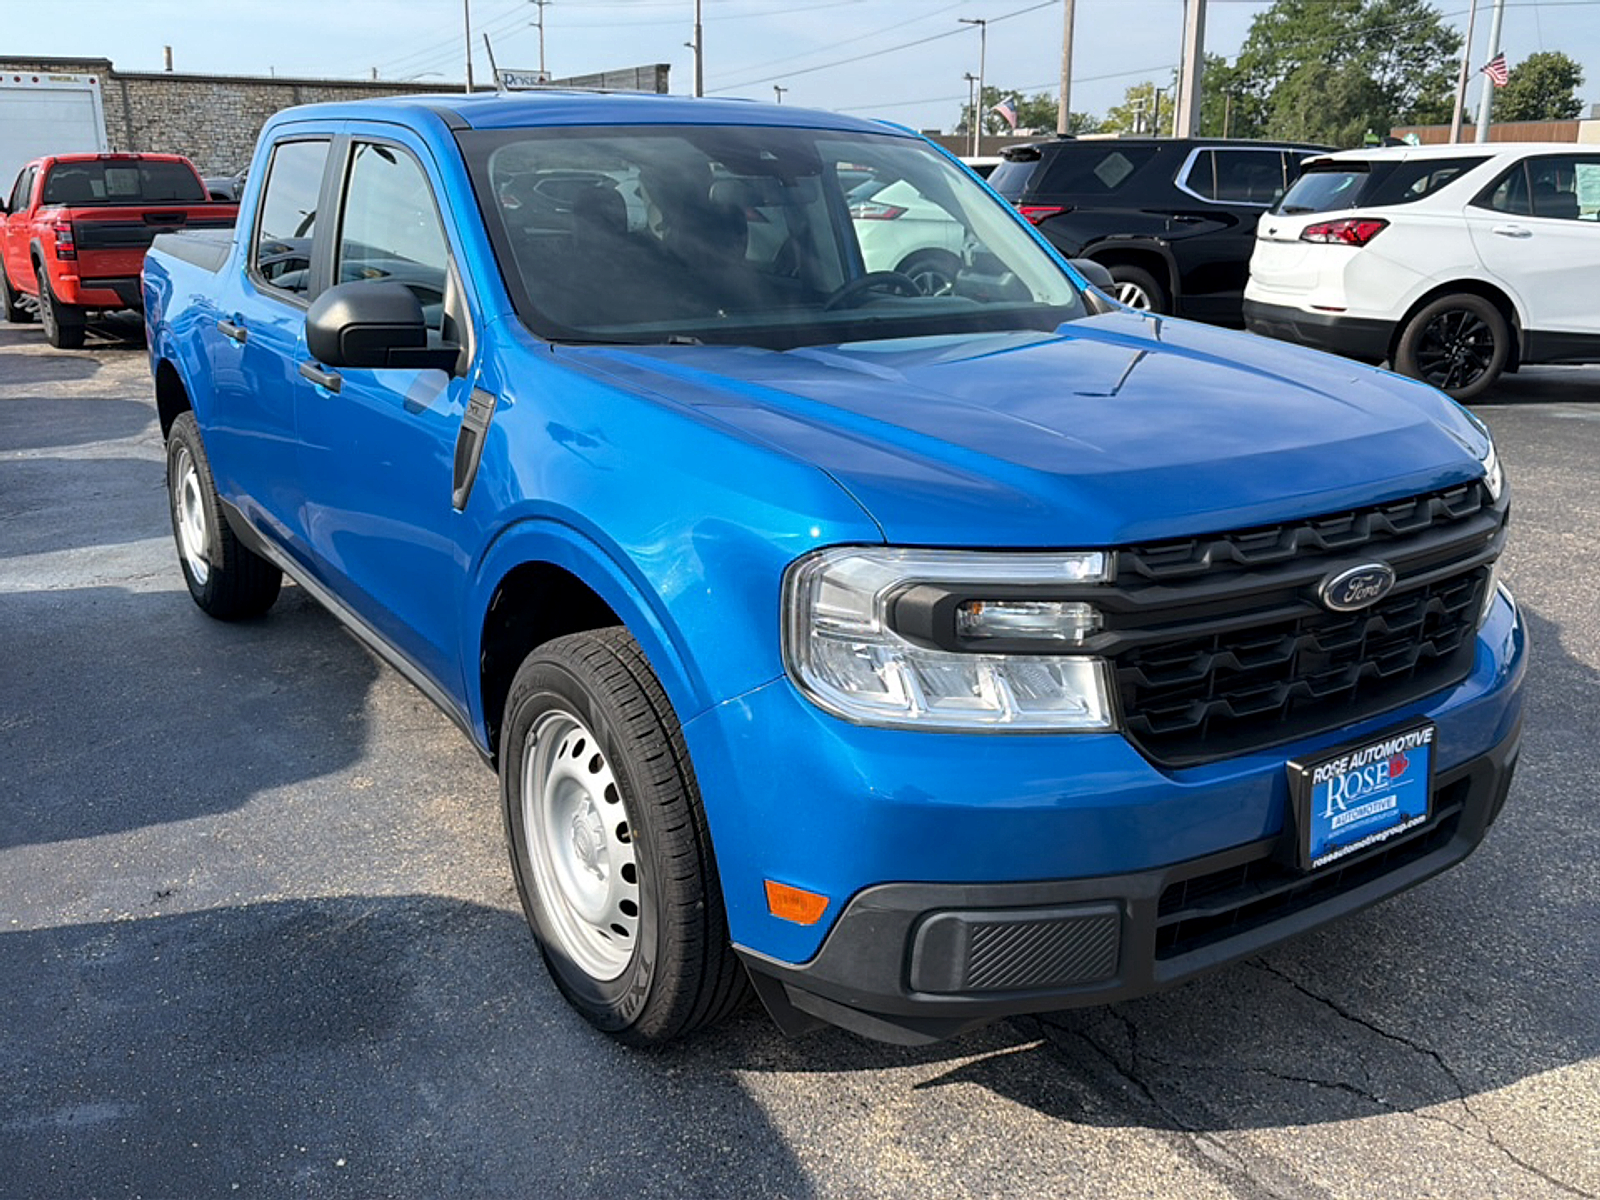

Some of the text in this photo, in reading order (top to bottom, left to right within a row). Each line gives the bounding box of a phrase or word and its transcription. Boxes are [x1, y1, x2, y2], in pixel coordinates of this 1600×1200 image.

[1344, 574, 1383, 603] Ford
[1313, 727, 1434, 785] ROSE AUTOMOTIVE
[1324, 761, 1391, 819] ROSE
